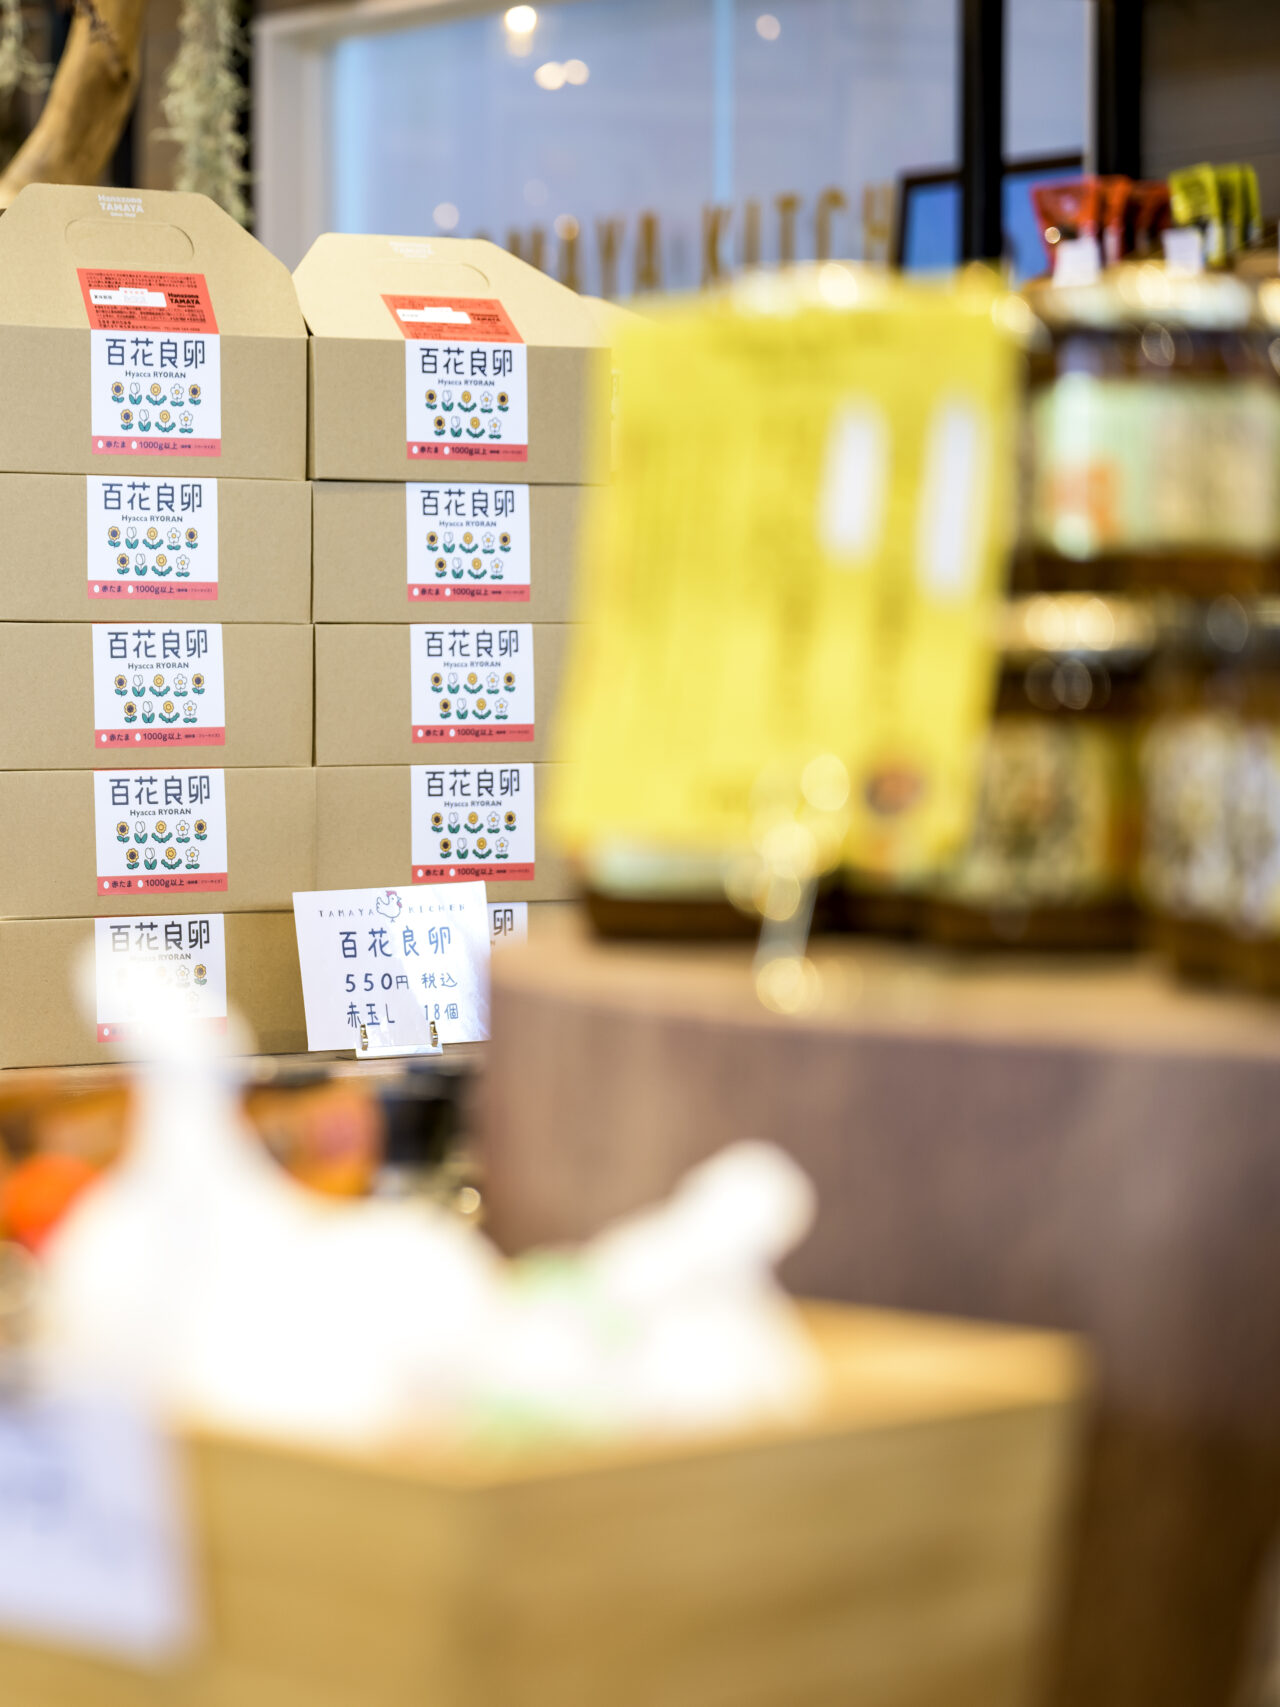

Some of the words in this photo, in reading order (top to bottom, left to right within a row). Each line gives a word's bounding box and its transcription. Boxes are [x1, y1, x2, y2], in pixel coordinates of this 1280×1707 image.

[99, 202, 144, 213] TAMAYA
[106, 337, 205, 369] 百花良卵
[419, 347, 512, 377] 百花良卵
[125, 370, 151, 379] Hyacca
[153, 371, 186, 379] RYORAN
[102, 481, 202, 512] 百花良卵
[420, 489, 514, 518] 百花良卵
[121, 514, 148, 523] Hyacca
[107, 629, 208, 659] 百花良卵
[425, 629, 518, 658] 百花良卵
[128, 662, 154, 671] Hyacca
[109, 775, 210, 806] 百花良卵
[425, 769, 520, 797] 百花良卵
[130, 809, 156, 817] Hyacca
[318, 908, 374, 918] TAMAYA
[109, 920, 210, 952] 百花良卵
[339, 925, 451, 958] 百花良卵
[345, 973, 410, 993] 550円
[421, 972, 458, 989] 税込
[347, 1001, 395, 1028] 赤玉L
[424, 1003, 459, 1021] 18個
